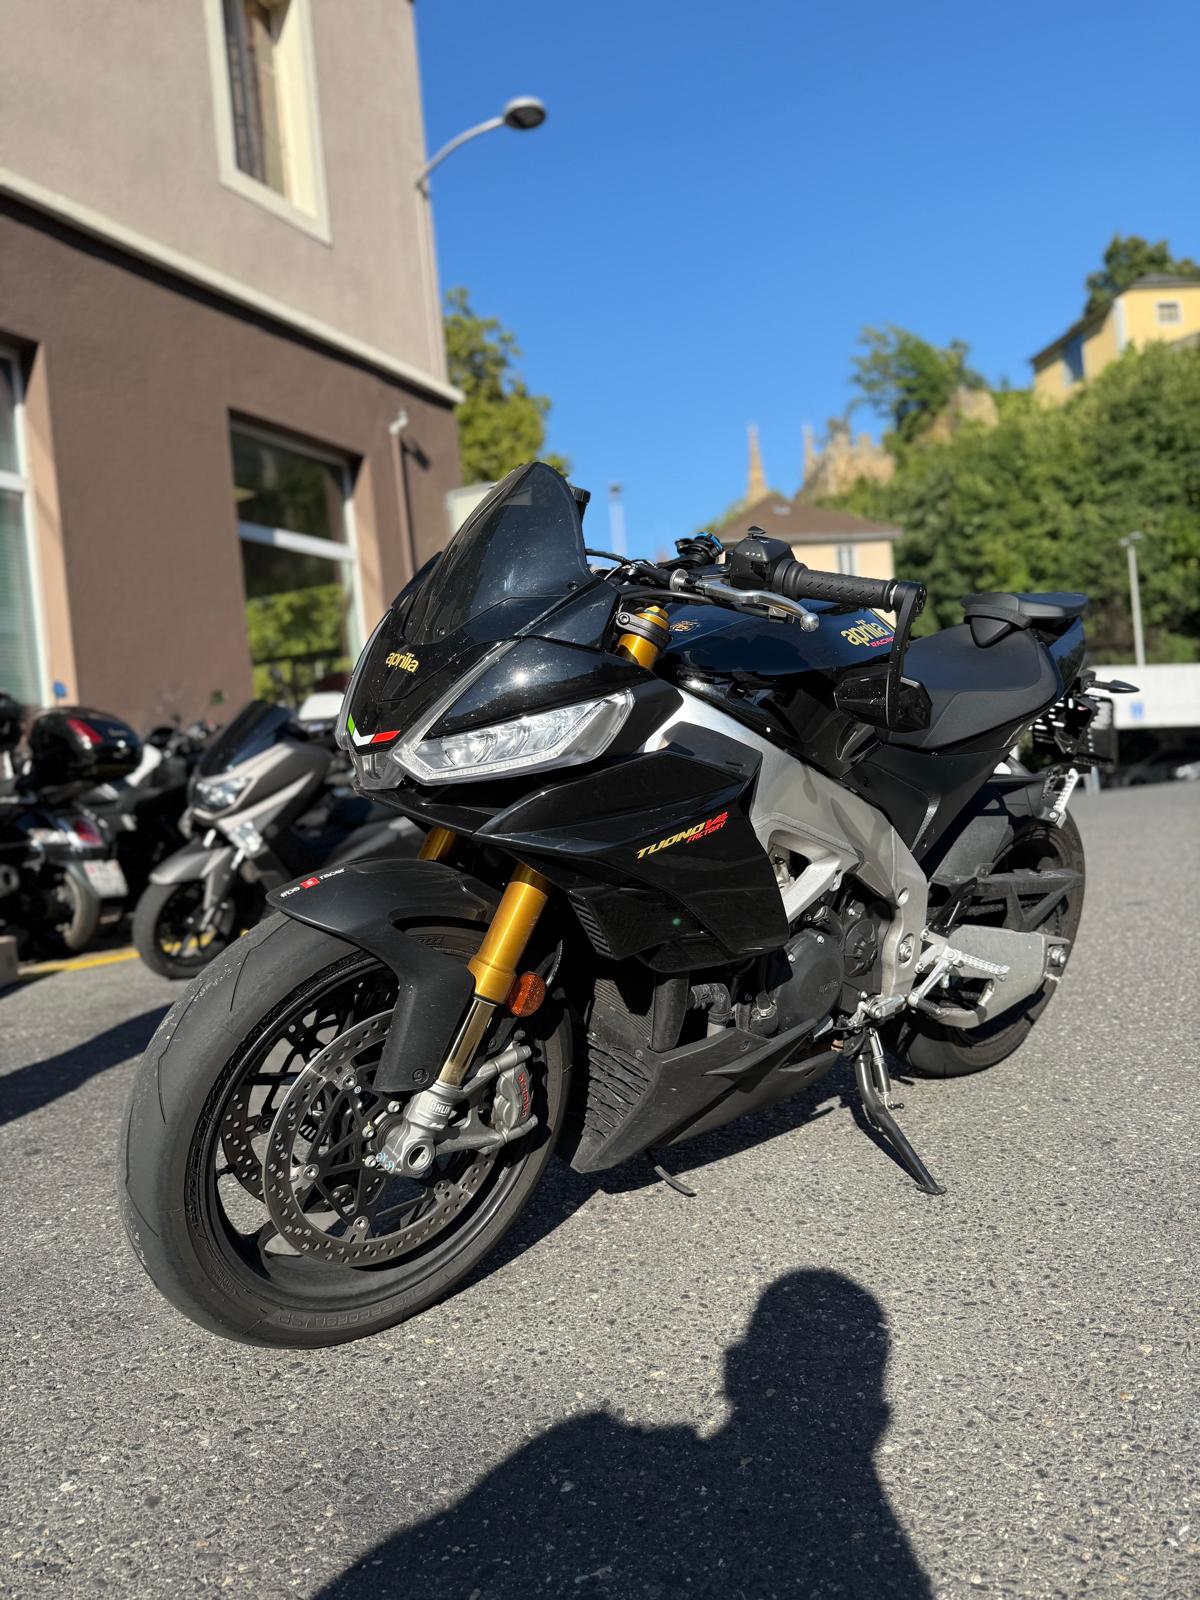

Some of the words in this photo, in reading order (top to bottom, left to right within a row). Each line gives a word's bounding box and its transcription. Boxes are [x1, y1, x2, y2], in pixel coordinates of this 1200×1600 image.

[841, 619, 890, 647] aprilia
[869, 636, 894, 647] RACIN
[386, 652, 419, 672] aprilia
[637, 822, 706, 859] TUONO
[686, 820, 727, 844] FACTORY
[319, 867, 345, 880] racer
